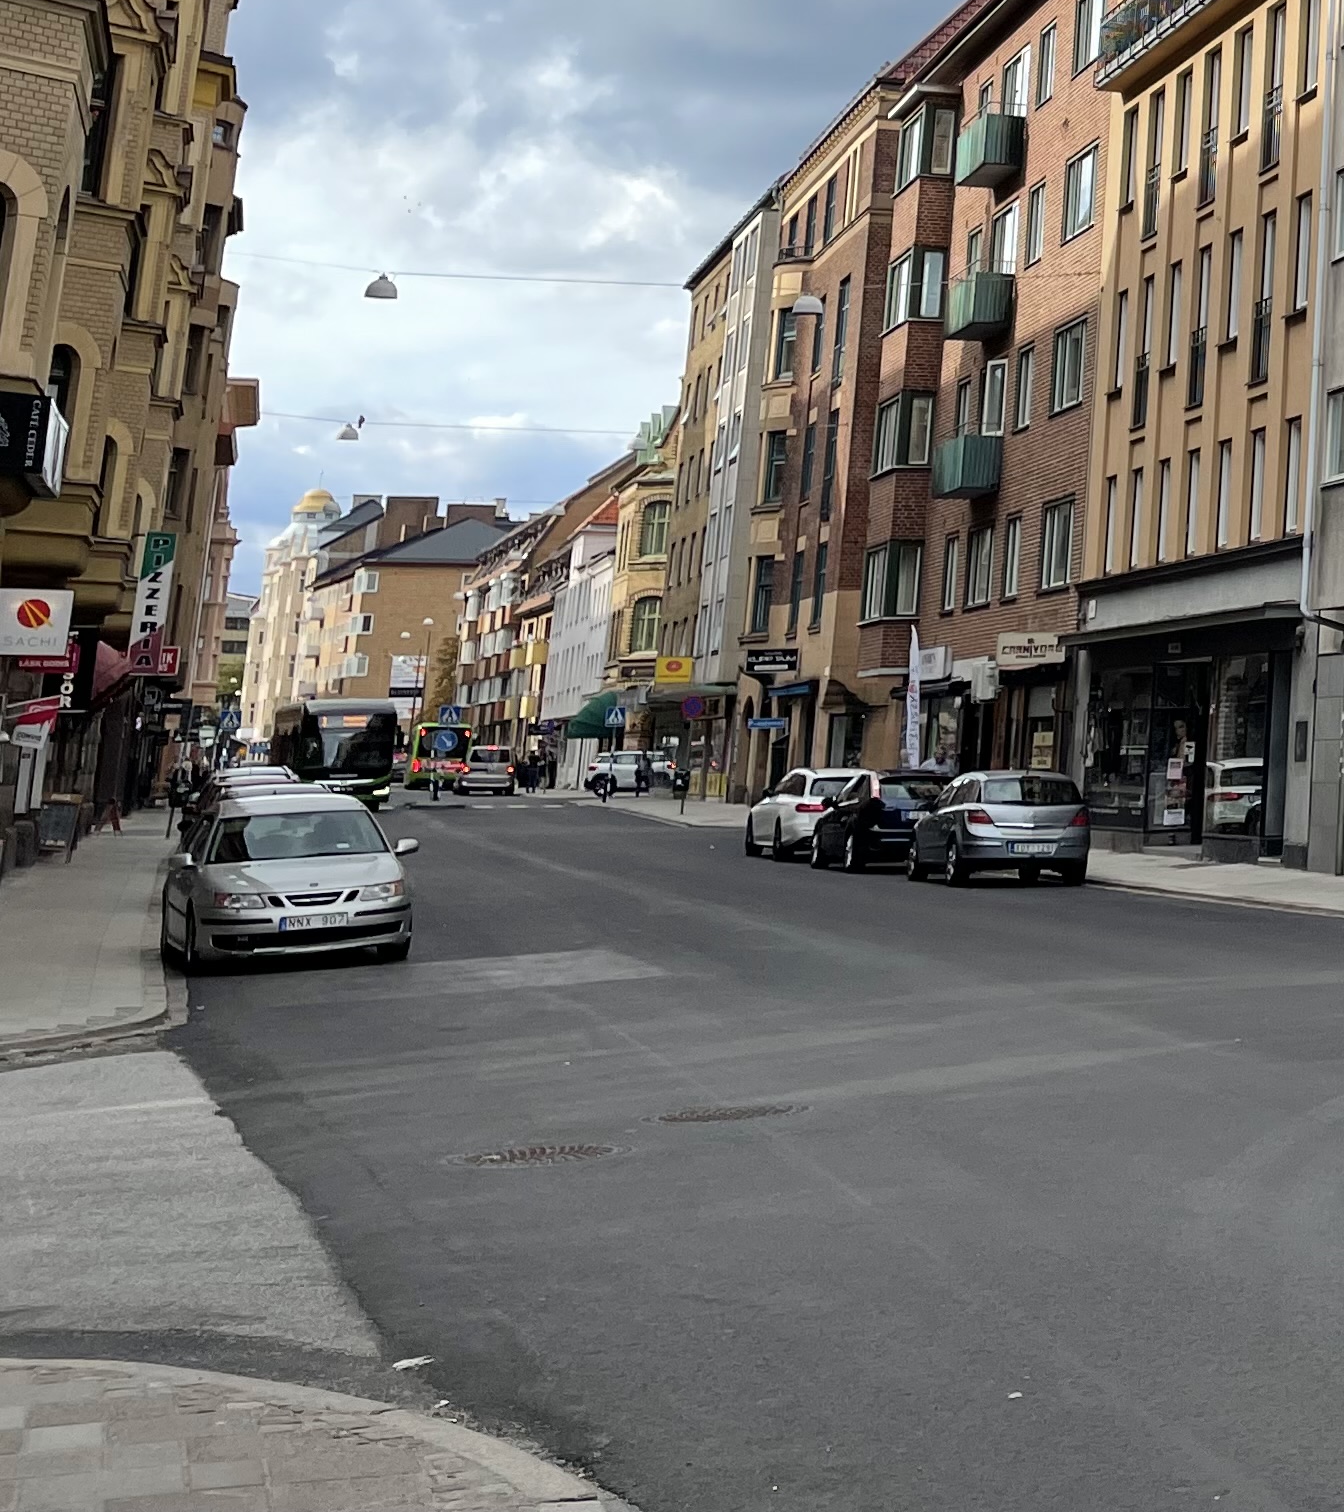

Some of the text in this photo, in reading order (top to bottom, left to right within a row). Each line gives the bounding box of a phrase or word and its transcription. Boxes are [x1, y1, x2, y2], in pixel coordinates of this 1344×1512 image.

[134, 536, 172, 668] PIZZERIA
[2, 636, 57, 648] SACHI
[288, 914, 345, 928] NNX 907
